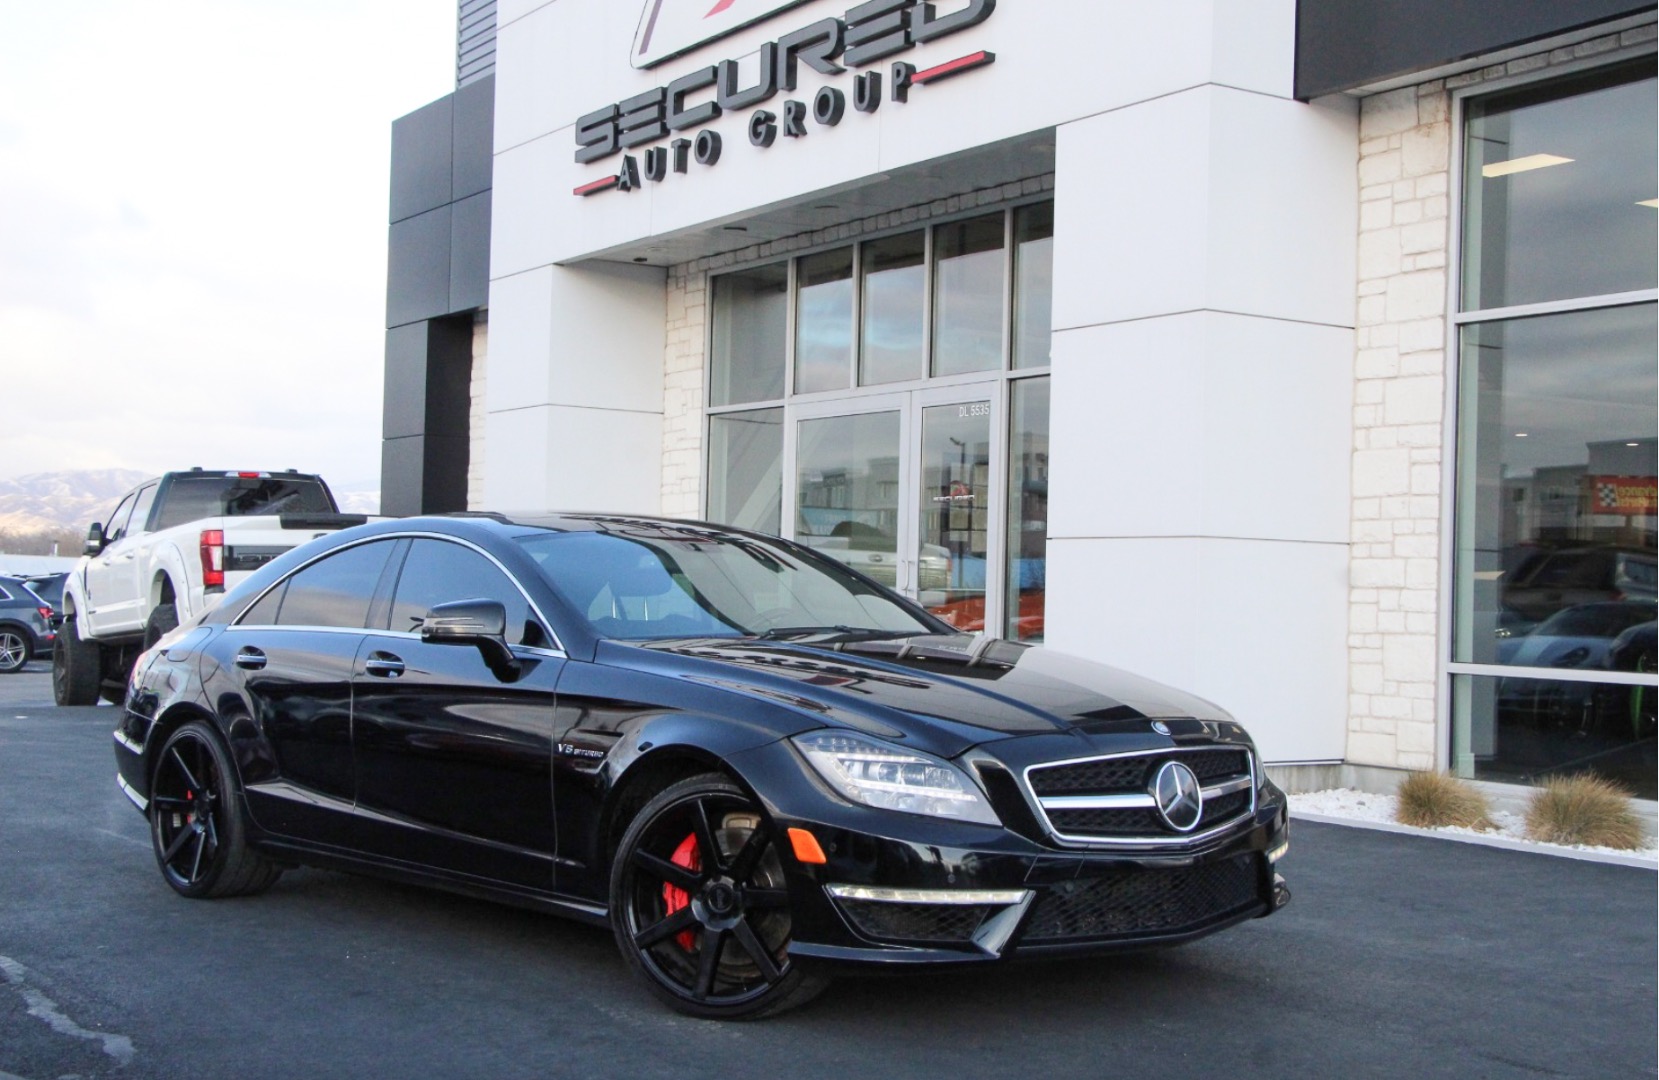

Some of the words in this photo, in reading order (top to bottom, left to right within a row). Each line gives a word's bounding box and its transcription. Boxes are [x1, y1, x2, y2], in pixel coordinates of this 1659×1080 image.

[617, 129, 723, 193] AUTO
[748, 61, 917, 149] GROUP
[959, 405, 970, 417] DL
[970, 403, 990, 416] 5535
